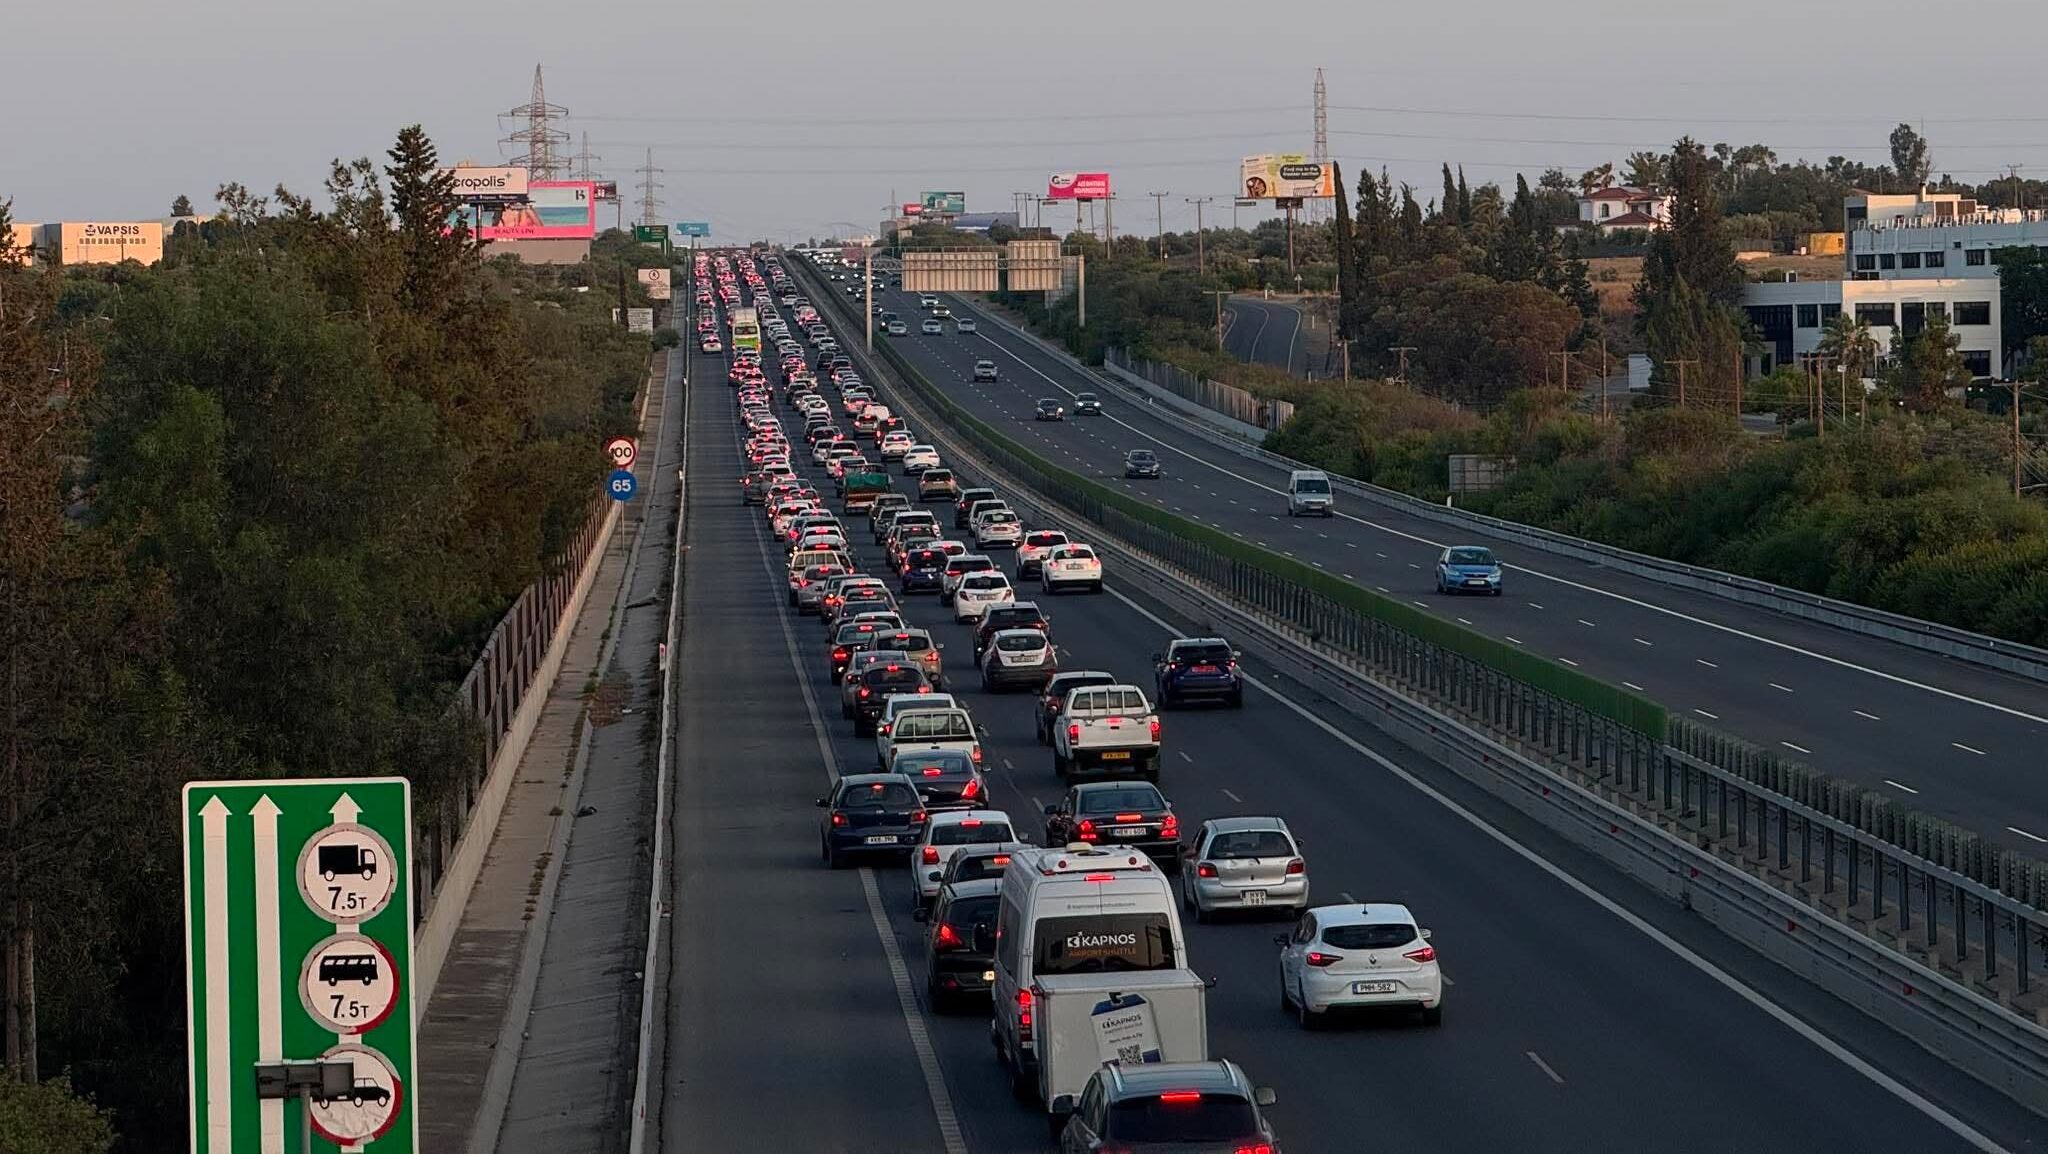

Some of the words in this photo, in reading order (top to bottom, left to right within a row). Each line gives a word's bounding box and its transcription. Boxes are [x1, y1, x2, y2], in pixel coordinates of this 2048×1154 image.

[452, 175, 506, 191] cropolis
[97, 225, 140, 235] VAPSIS
[612, 479, 632, 493] 65
[1081, 933, 1137, 947] KAPNOS
[1110, 1014, 1142, 1027] KAPNOS
